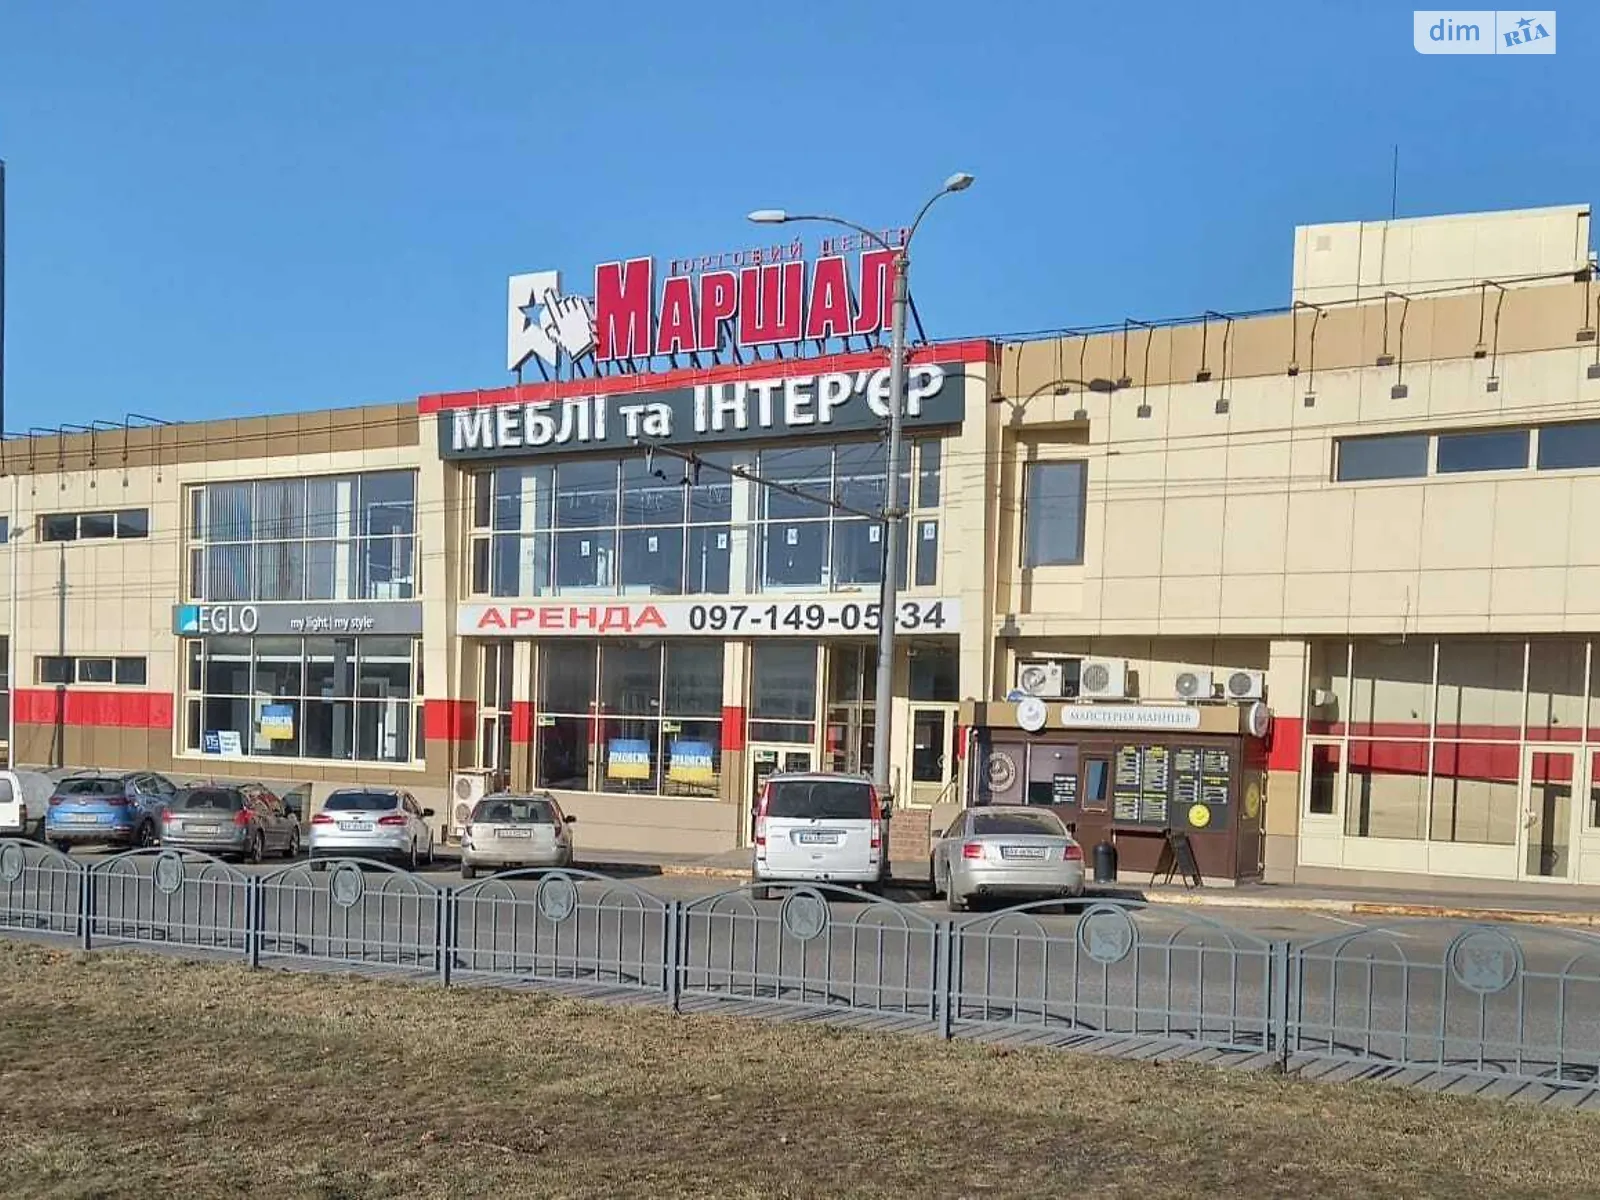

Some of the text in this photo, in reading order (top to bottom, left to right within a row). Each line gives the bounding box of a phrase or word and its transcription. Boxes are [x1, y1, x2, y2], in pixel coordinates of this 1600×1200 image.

[671, 226, 912, 276] ТОРГОВИЙ ЦЕНТР
[594, 247, 904, 362] МАРШАЛ
[452, 394, 609, 451] МЕБЛІ
[619, 402, 673, 437] та
[200, 605, 373, 633] EGLO my light my style
[477, 601, 946, 632] АРЕНДА 097-149-0534
